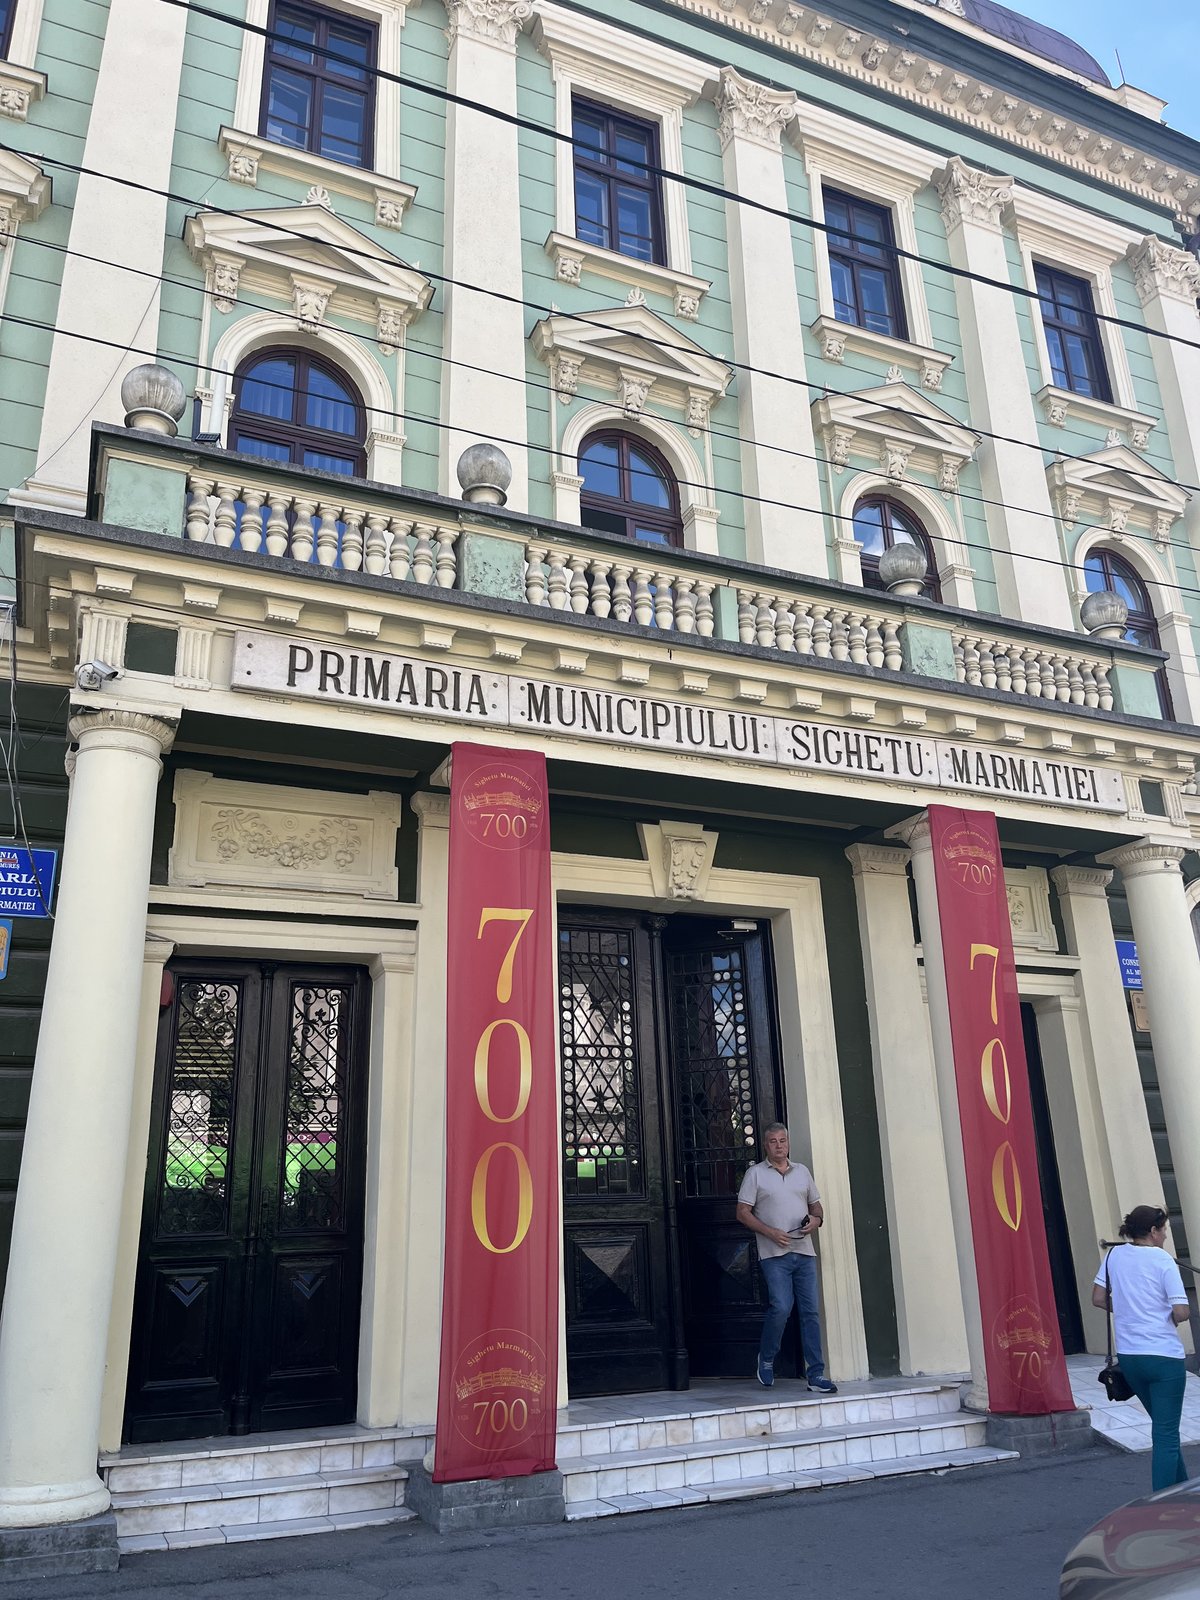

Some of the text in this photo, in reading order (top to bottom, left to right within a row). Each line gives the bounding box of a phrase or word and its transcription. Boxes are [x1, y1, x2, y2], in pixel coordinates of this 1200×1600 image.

[286, 644, 1100, 803] PRIMARIA MUNICIPIULUI SIGHETU MARMATIEI
[480, 813, 527, 839] 700
[958, 862, 992, 886] 700
[471, 907, 535, 1254] 700
[970, 943, 1023, 1232] 700
[473, 1398, 528, 1436] 700
